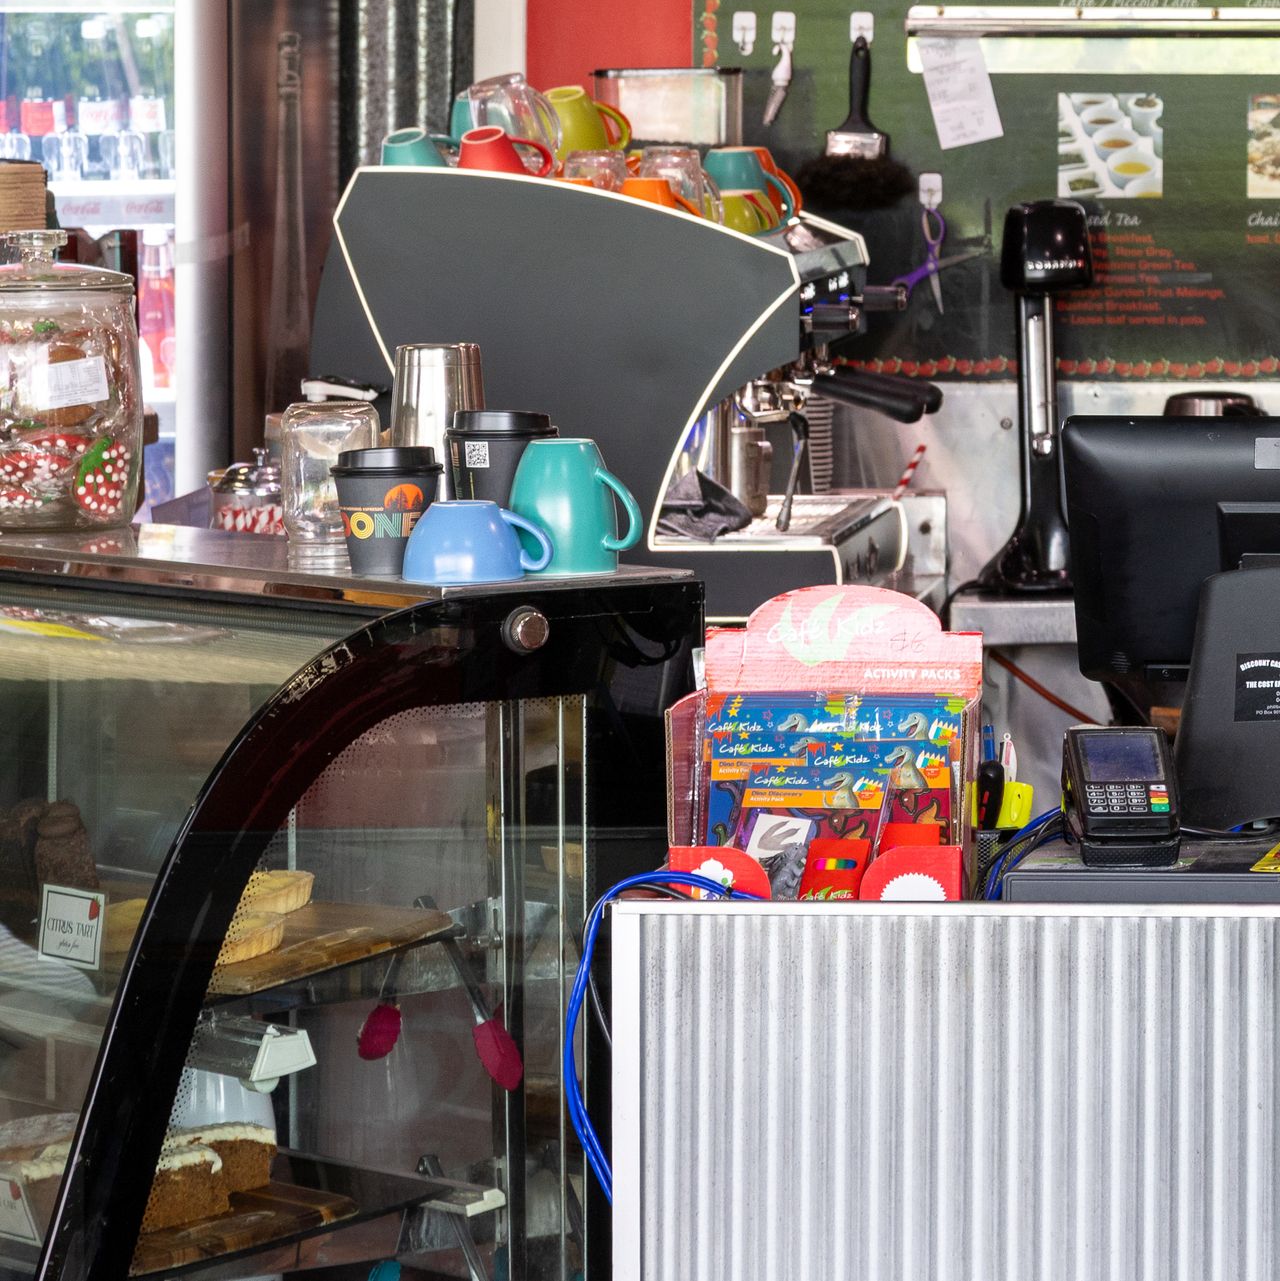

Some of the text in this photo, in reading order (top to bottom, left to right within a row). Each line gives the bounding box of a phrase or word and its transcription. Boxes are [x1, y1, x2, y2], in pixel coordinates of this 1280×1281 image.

[1116, 213, 1141, 226] Tea
[767, 618, 888, 649] Café Kidz
[1240, 660, 1270, 671] DISCOUNT
[864, 668, 961, 680] ACTIVITY PACKS
[738, 722, 763, 732] Kidz
[754, 776, 809, 786] Café Kidz
[47, 917, 95, 939] CITRUS TART
